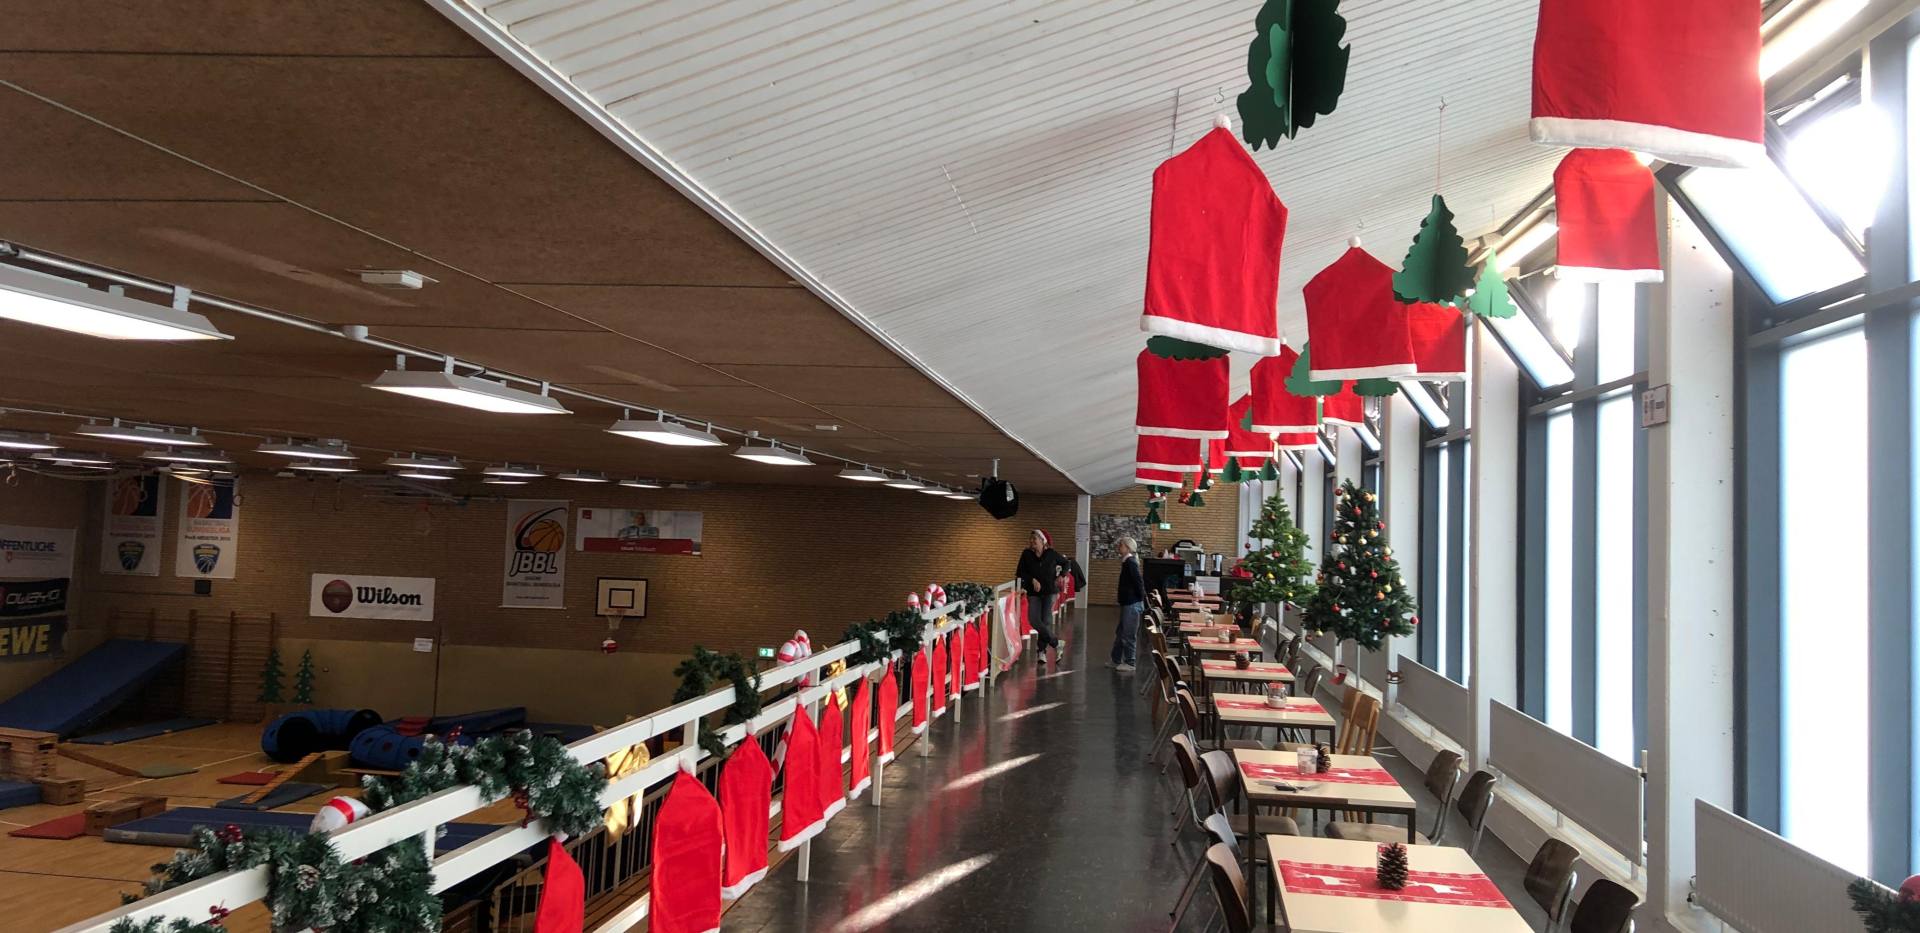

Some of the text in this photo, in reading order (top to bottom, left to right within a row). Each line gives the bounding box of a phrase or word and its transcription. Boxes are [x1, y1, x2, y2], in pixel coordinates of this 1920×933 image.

[0, 540, 56, 552] FFENTLICHE
[509, 550, 558, 577] JBBL
[357, 587, 423, 605] Wilson
